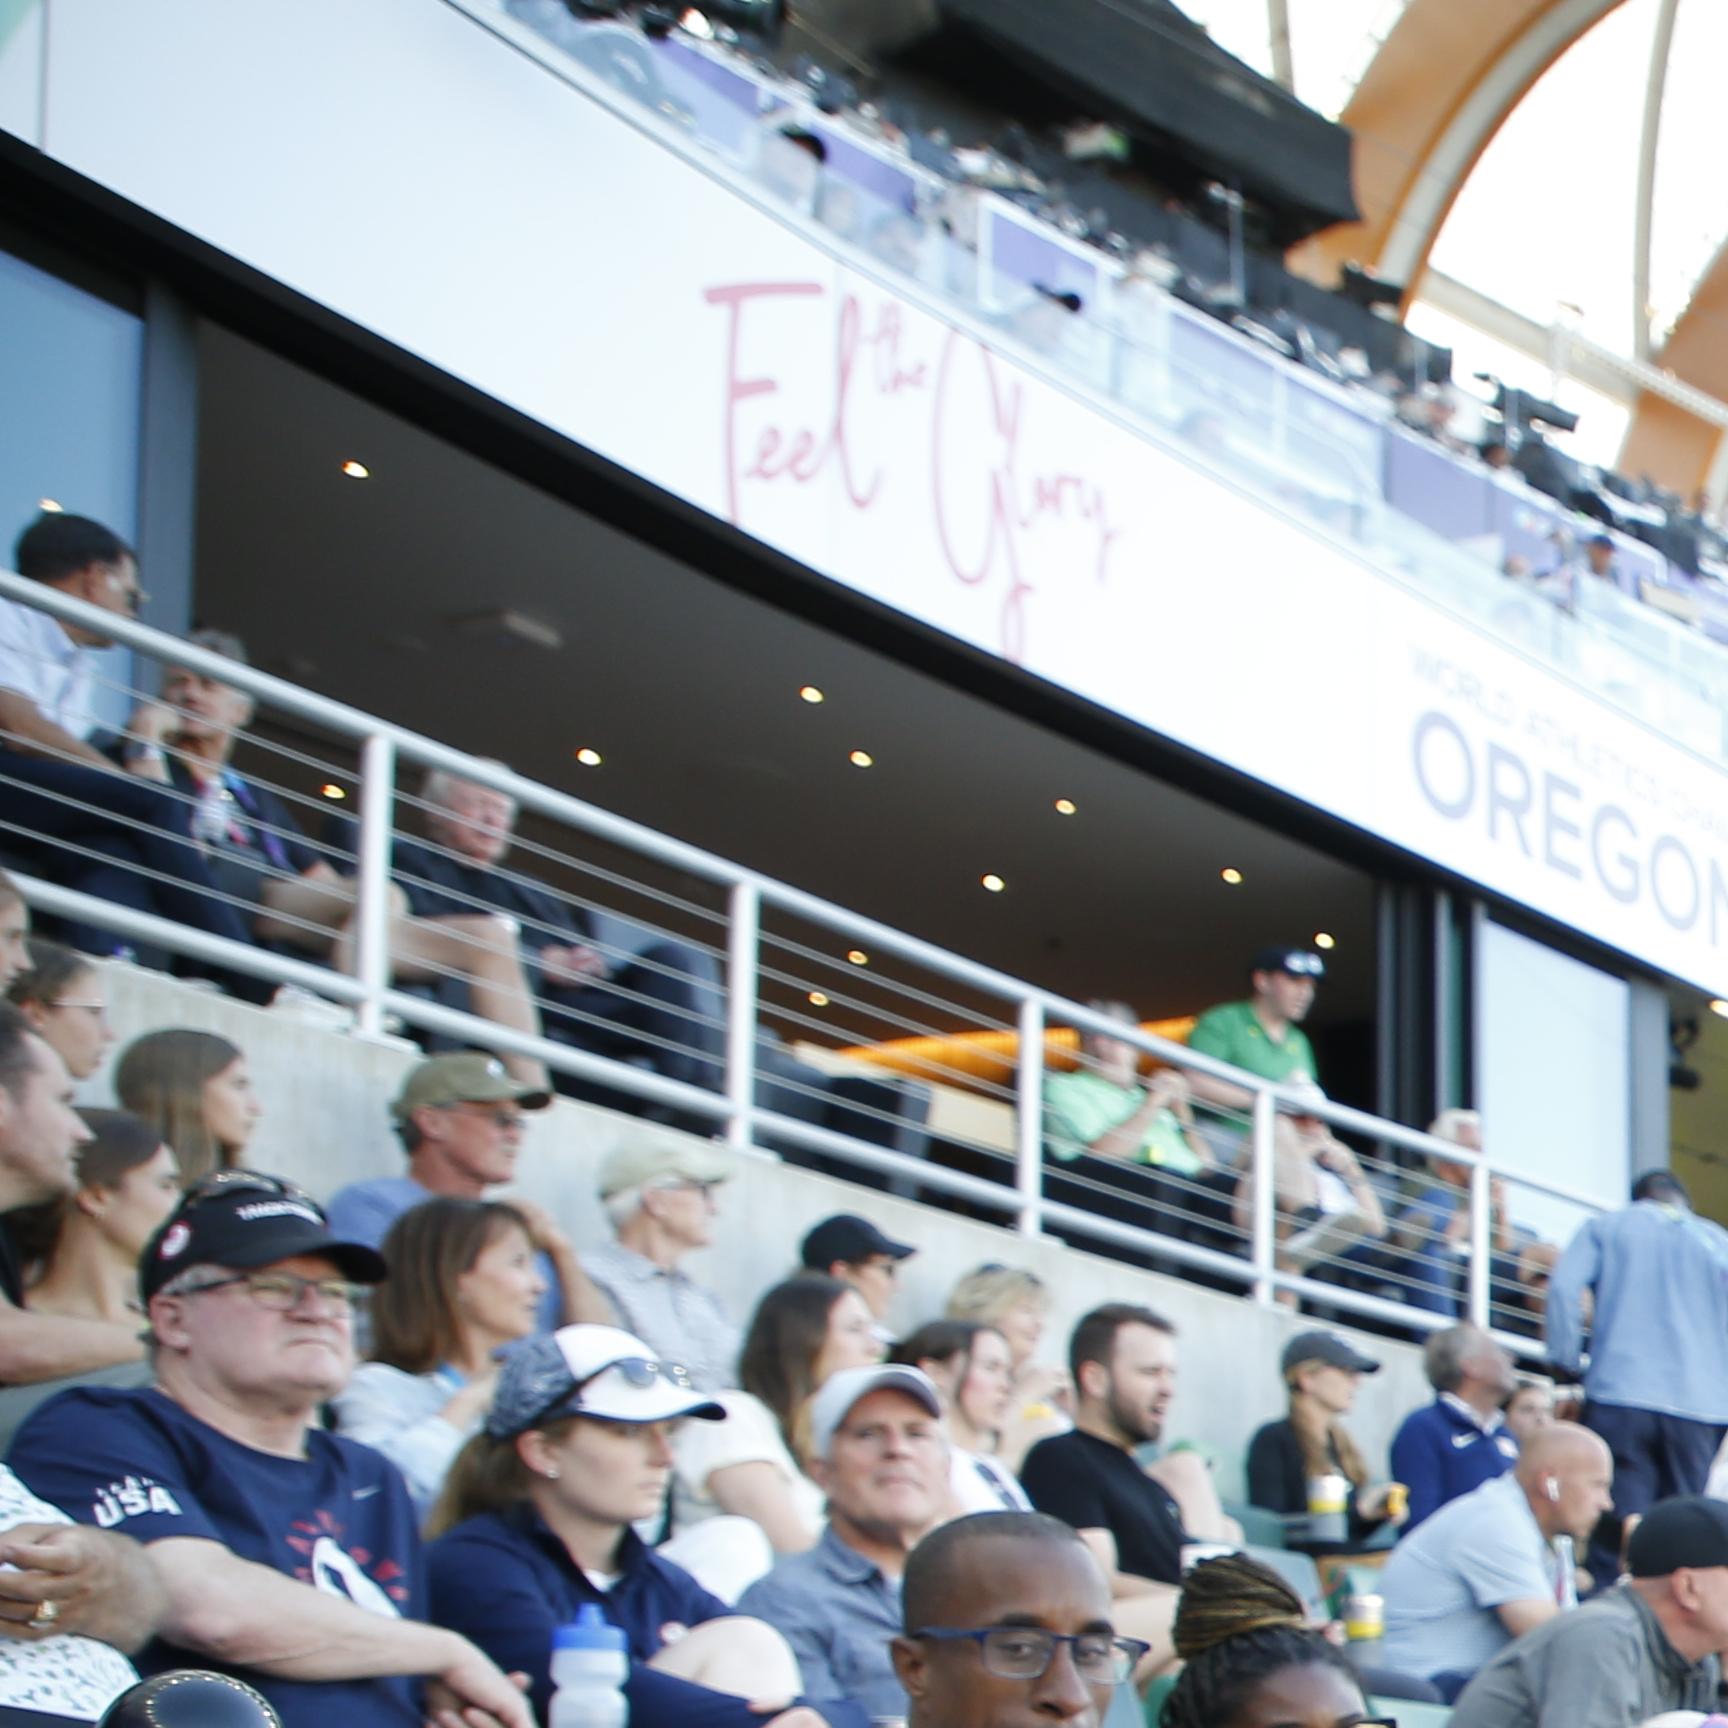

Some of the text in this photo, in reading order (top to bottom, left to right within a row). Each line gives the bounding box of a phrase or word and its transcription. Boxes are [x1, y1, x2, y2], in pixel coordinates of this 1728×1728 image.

[704, 282, 884, 526] Feel
[864, 301, 930, 394] the
[92, 1485, 184, 1529] USA
